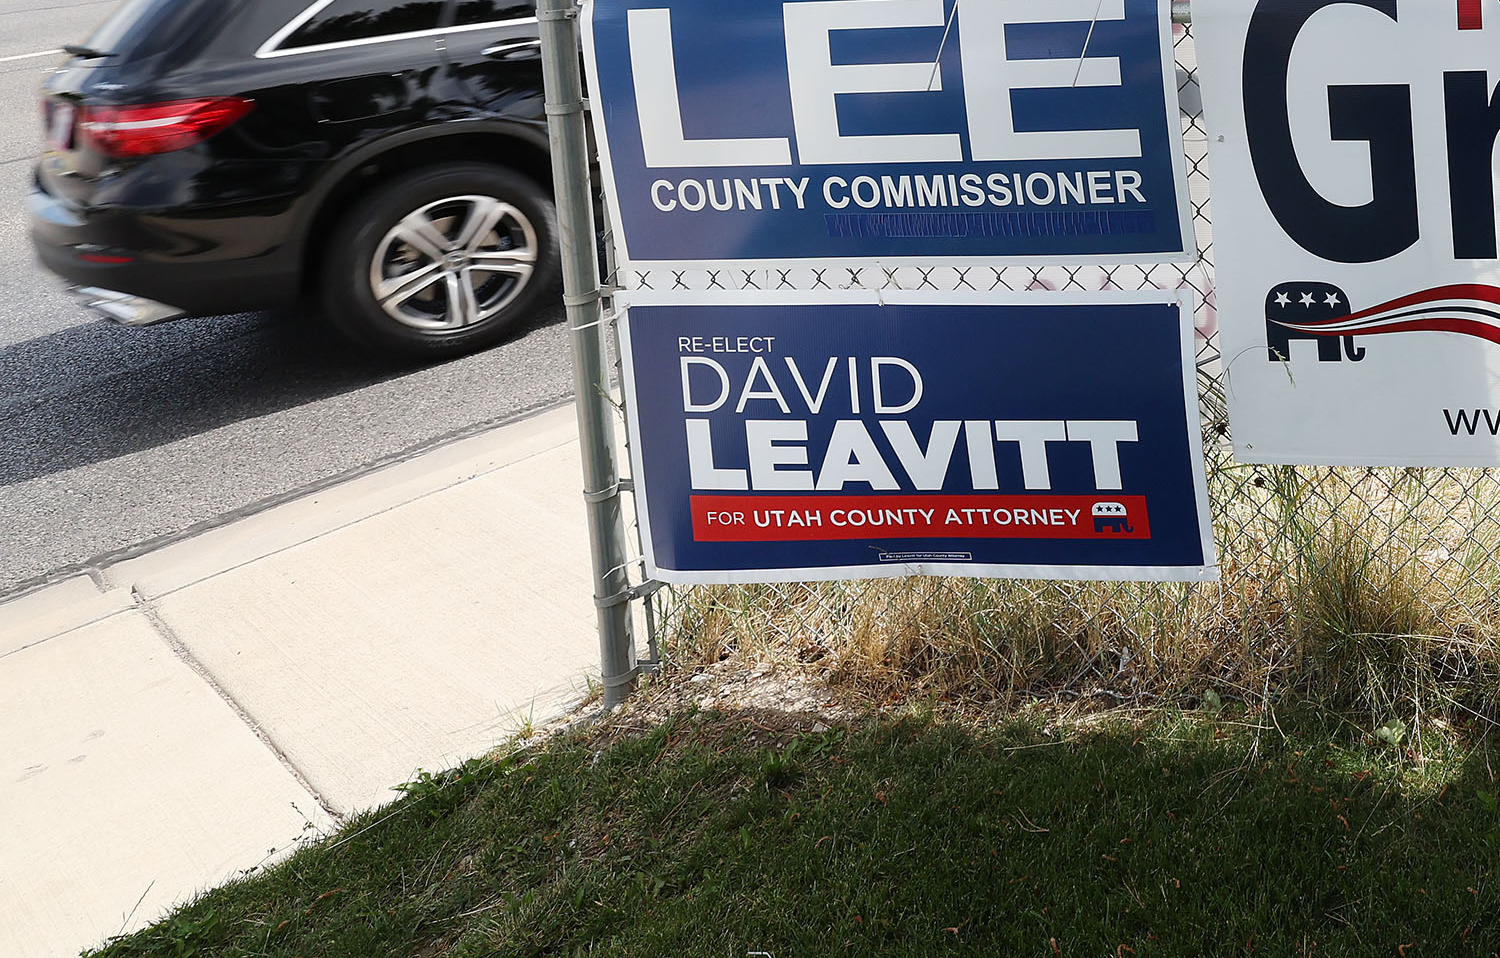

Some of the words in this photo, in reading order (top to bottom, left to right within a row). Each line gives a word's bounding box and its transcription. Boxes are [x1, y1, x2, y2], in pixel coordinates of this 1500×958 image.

[650, 176, 809, 212] COUNTY
[823, 170, 1146, 209] COMMISSIONER
[678, 337, 775, 353] RE-ELECT
[680, 356, 924, 414] DAVID
[686, 418, 1138, 491] LEAVITT
[707, 510, 745, 527] FOR
[753, 509, 822, 528] UTAH
[830, 508, 935, 527] COUNTY
[944, 507, 1081, 527] ATTORNEY
